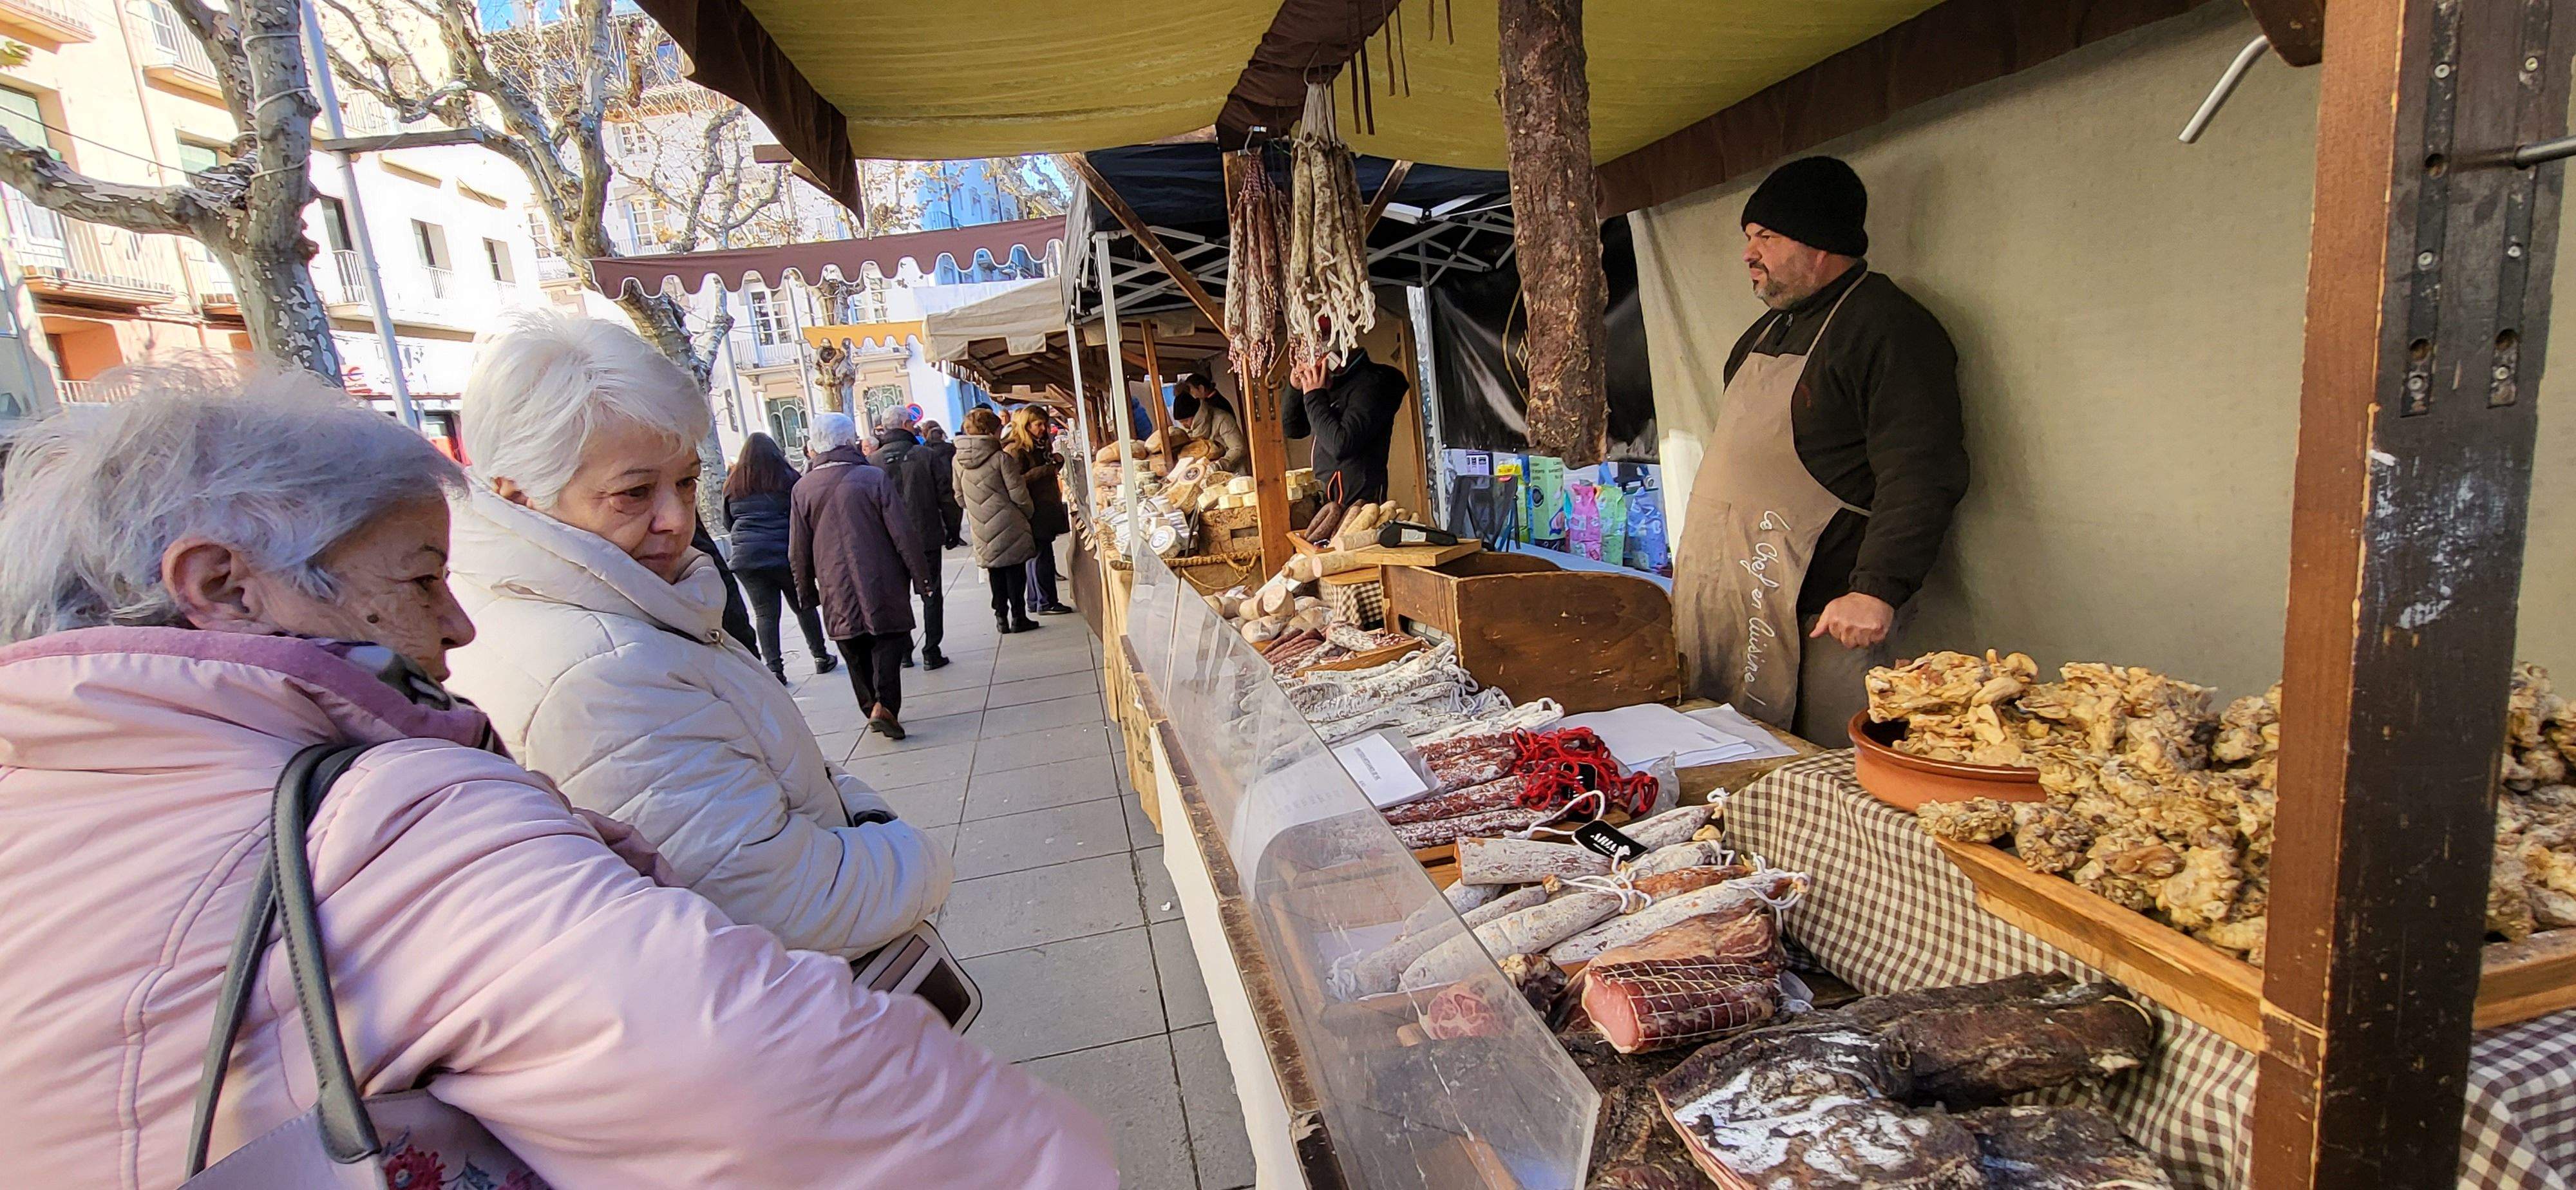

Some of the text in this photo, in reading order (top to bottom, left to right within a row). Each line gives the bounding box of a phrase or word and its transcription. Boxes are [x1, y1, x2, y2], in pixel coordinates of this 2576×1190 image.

[1739, 543, 1779, 588] Chef
[1752, 589, 1763, 609] en
[1745, 617, 1775, 683] Cuisine
